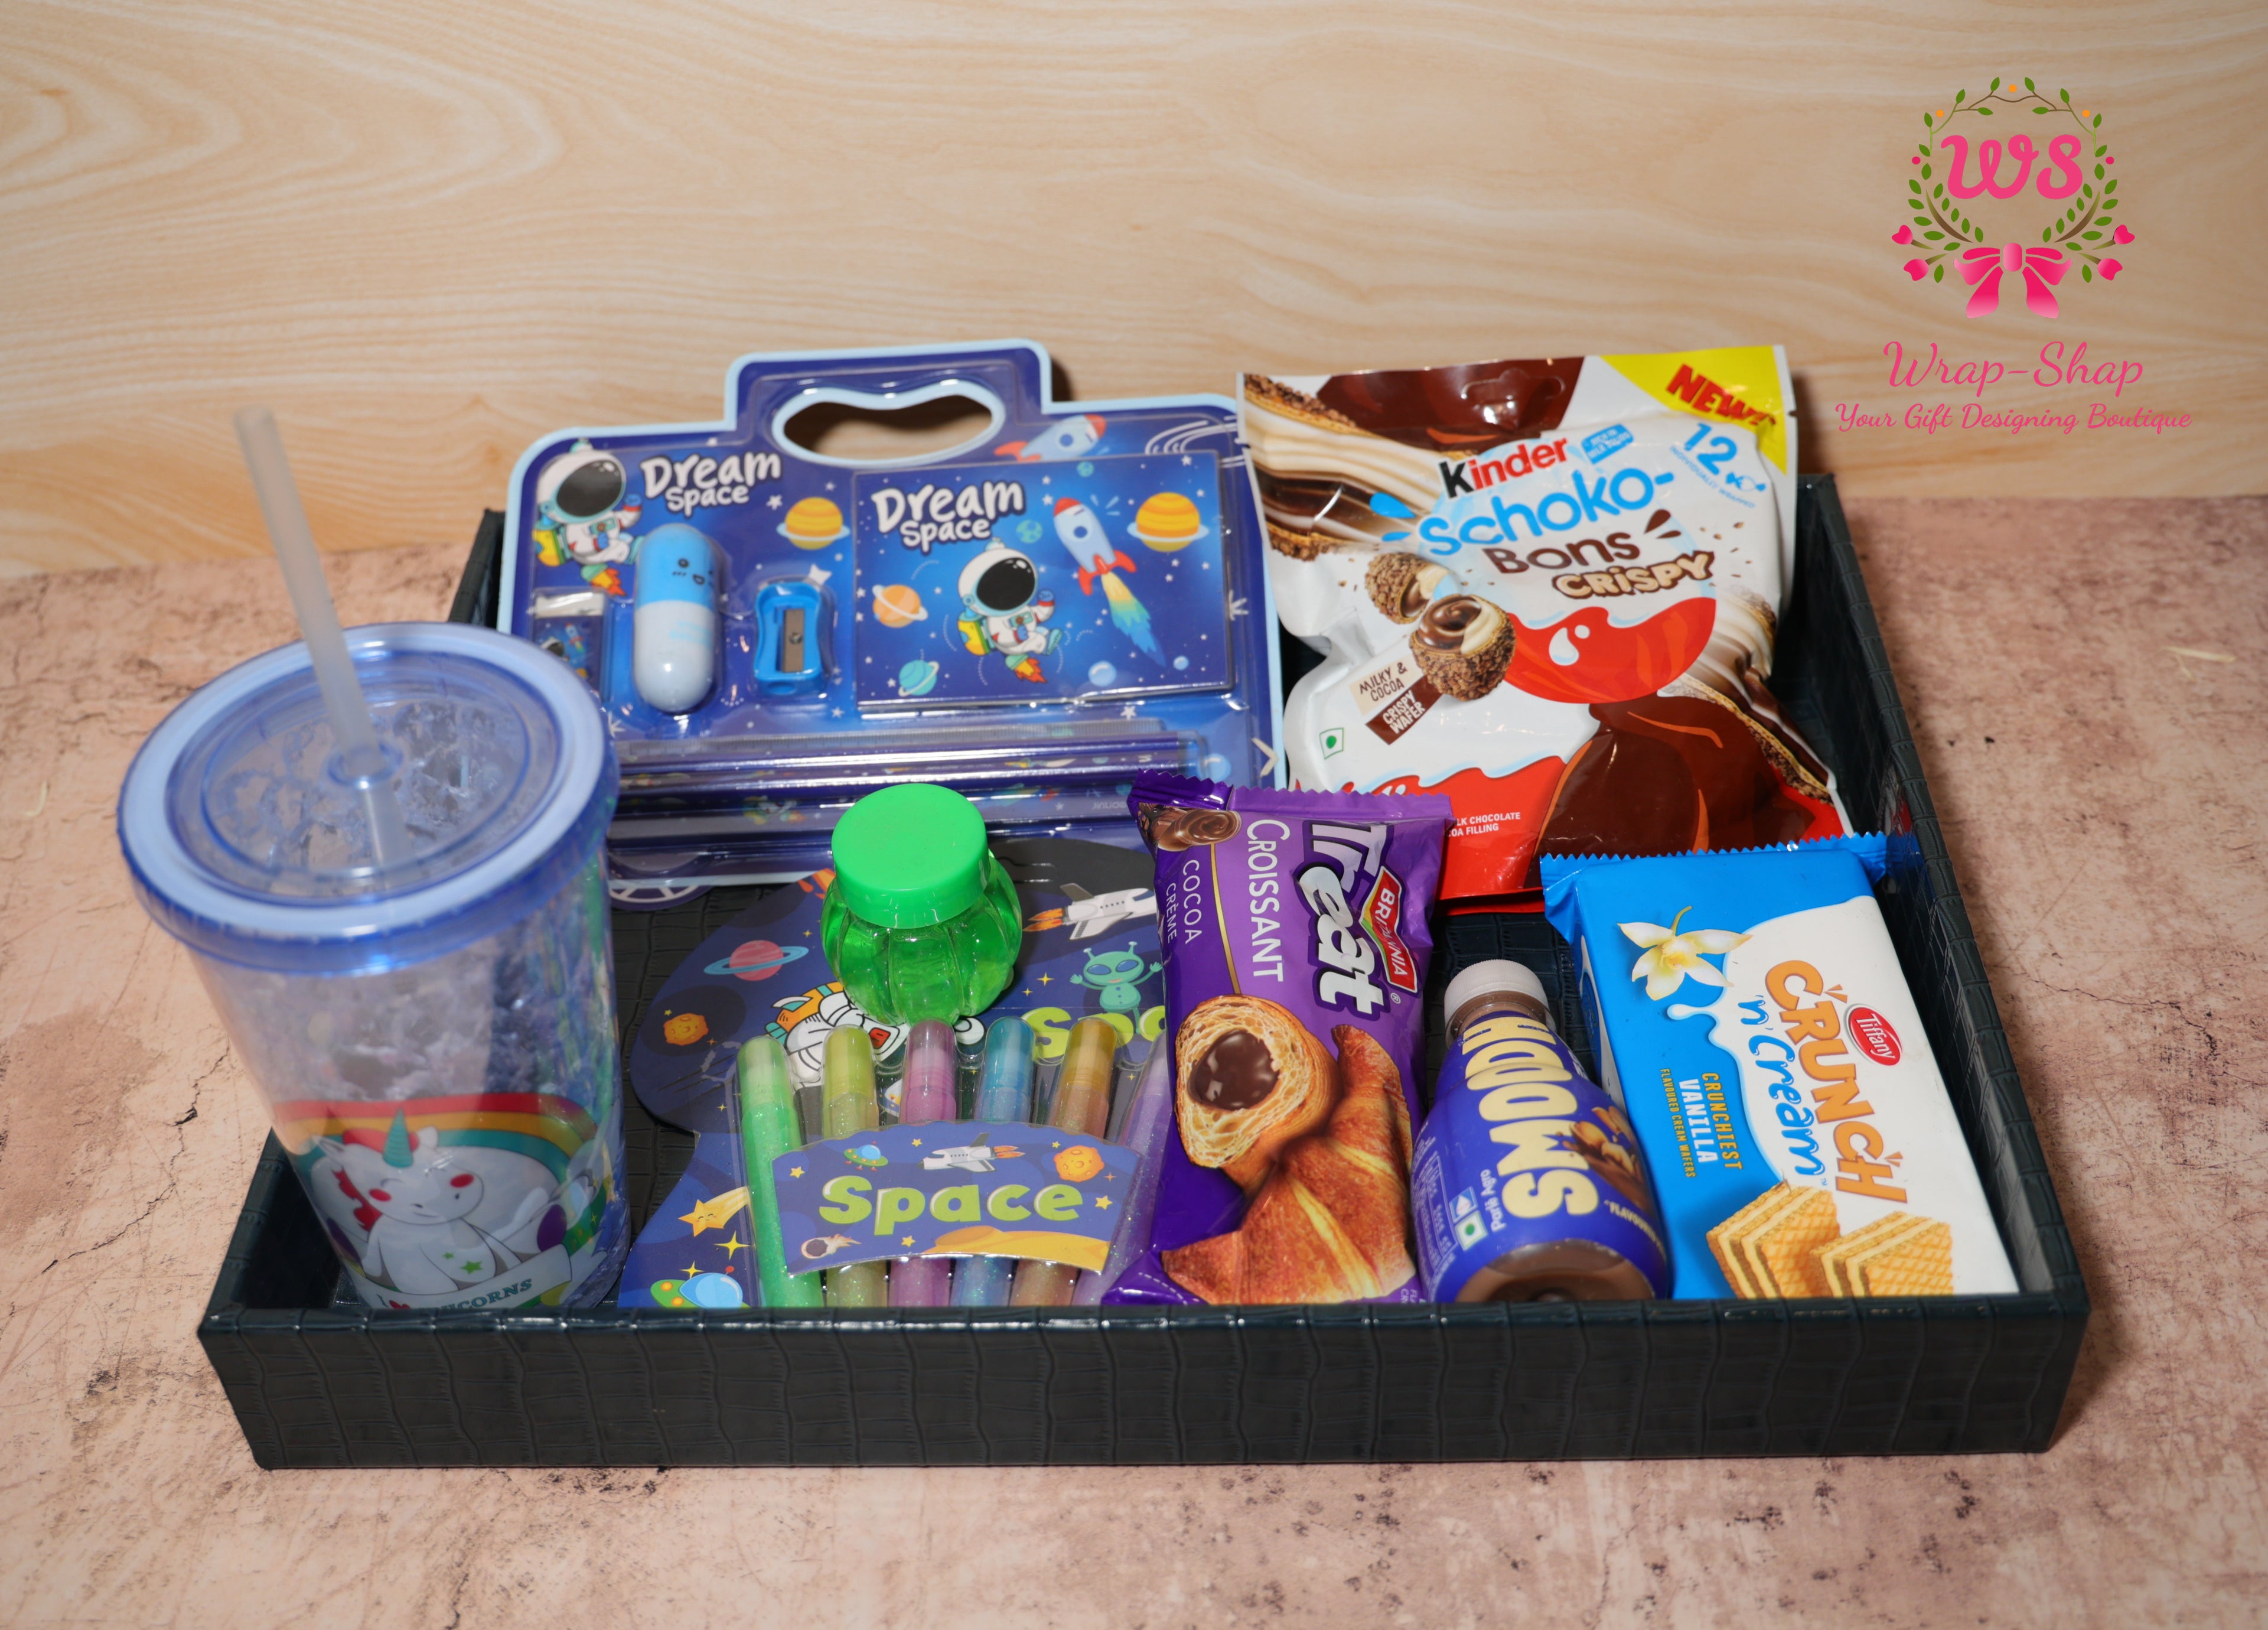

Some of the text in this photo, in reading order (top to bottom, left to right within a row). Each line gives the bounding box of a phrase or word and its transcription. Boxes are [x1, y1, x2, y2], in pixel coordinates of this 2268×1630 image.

[1684, 422, 1738, 475] 12
[639, 453, 781, 498] Dream
[871, 481, 1025, 533] Dream
[1359, 662, 1407, 695] MILKY &
[1370, 678, 1405, 702] COCOA
[1382, 689, 1417, 725] CRISPY
[1389, 701, 1426, 734] WAFER
[1456, 812, 1521, 826] LK CHOCOLATE
[1466, 823, 1500, 835] FILLING
[1183, 860, 1203, 945] COCOA
[1247, 819, 1290, 982] CROISSANT
[1299, 825, 1387, 1015] Treat
[1856, 1013, 1896, 1059] Tiffany
[1748, 1034, 1826, 1176] Cream
[1765, 959, 1908, 1203] CRUNCH
[1660, 1068, 1697, 1178] FLAVOURED CREAM WAFERS
[1679, 1078, 1719, 1163] VANILLA
[1702, 1072, 1744, 1170] CRUNCHIEST
[819, 1175, 1084, 1236] Space
[1480, 1169, 1497, 1197] Agro
